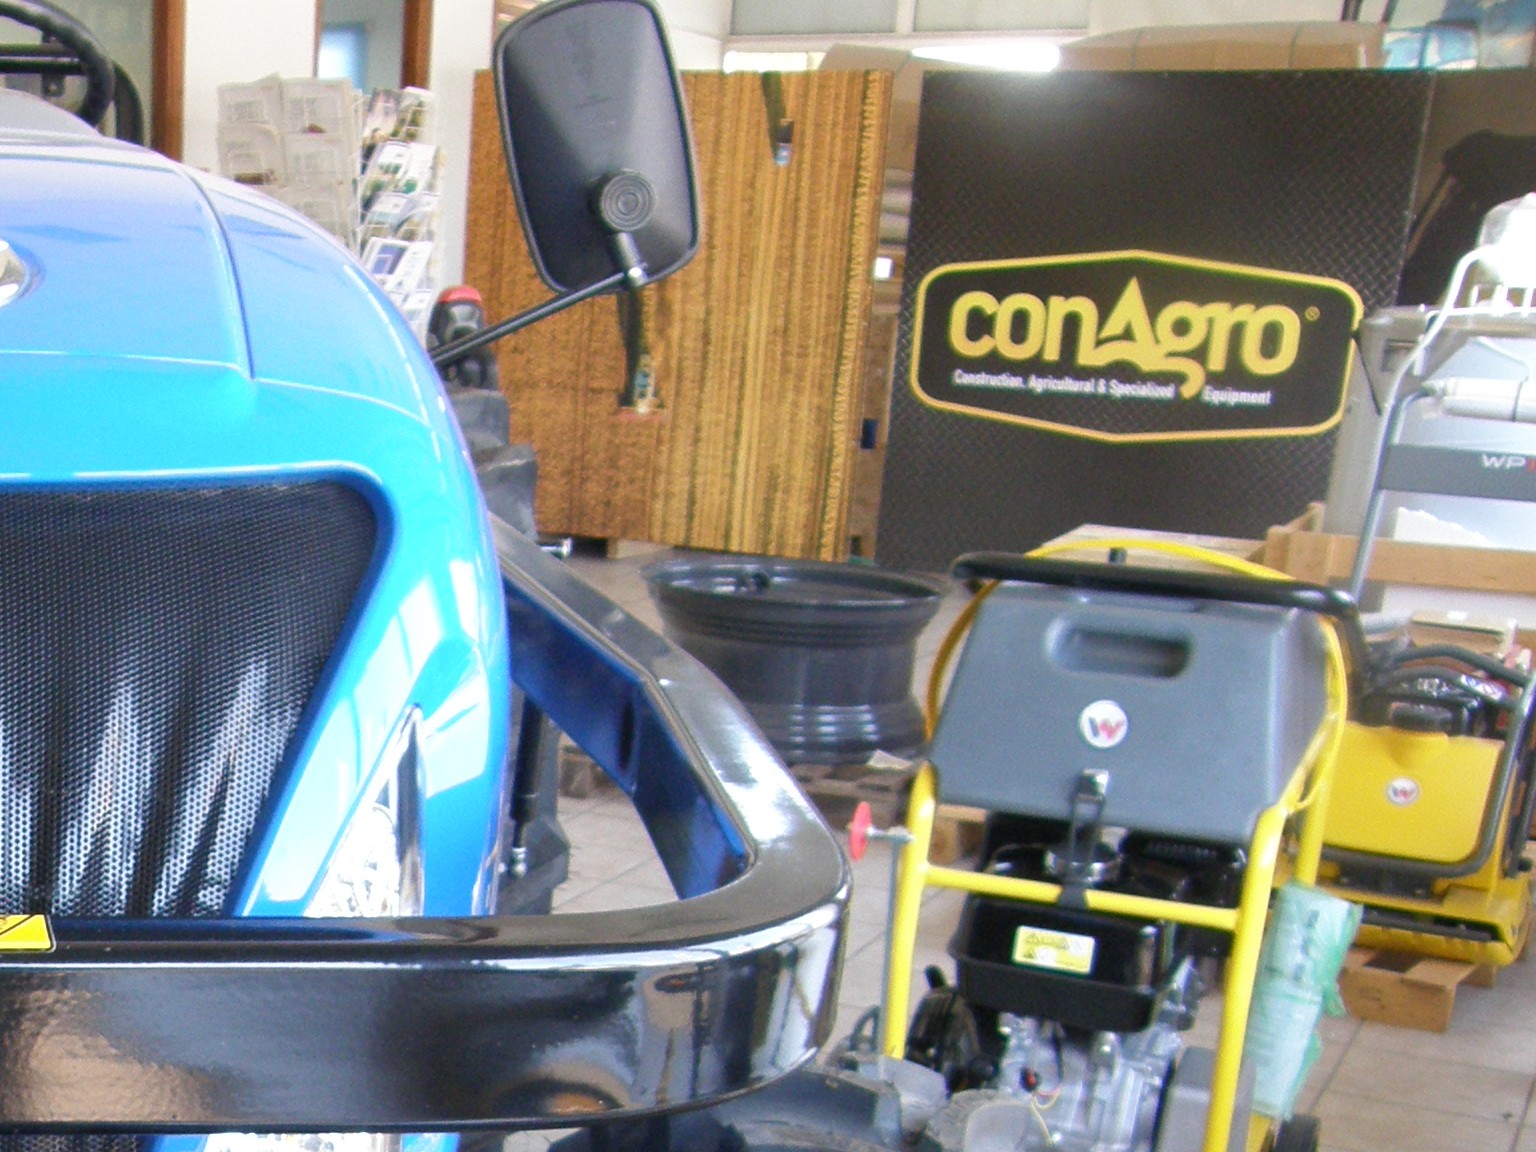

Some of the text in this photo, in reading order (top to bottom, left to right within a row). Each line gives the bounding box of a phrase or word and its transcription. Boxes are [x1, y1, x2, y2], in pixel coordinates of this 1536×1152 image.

[1028, 374, 1095, 394] Agricultural
[1097, 378, 1107, 394] &
[1203, 384, 1271, 406] Equipment
